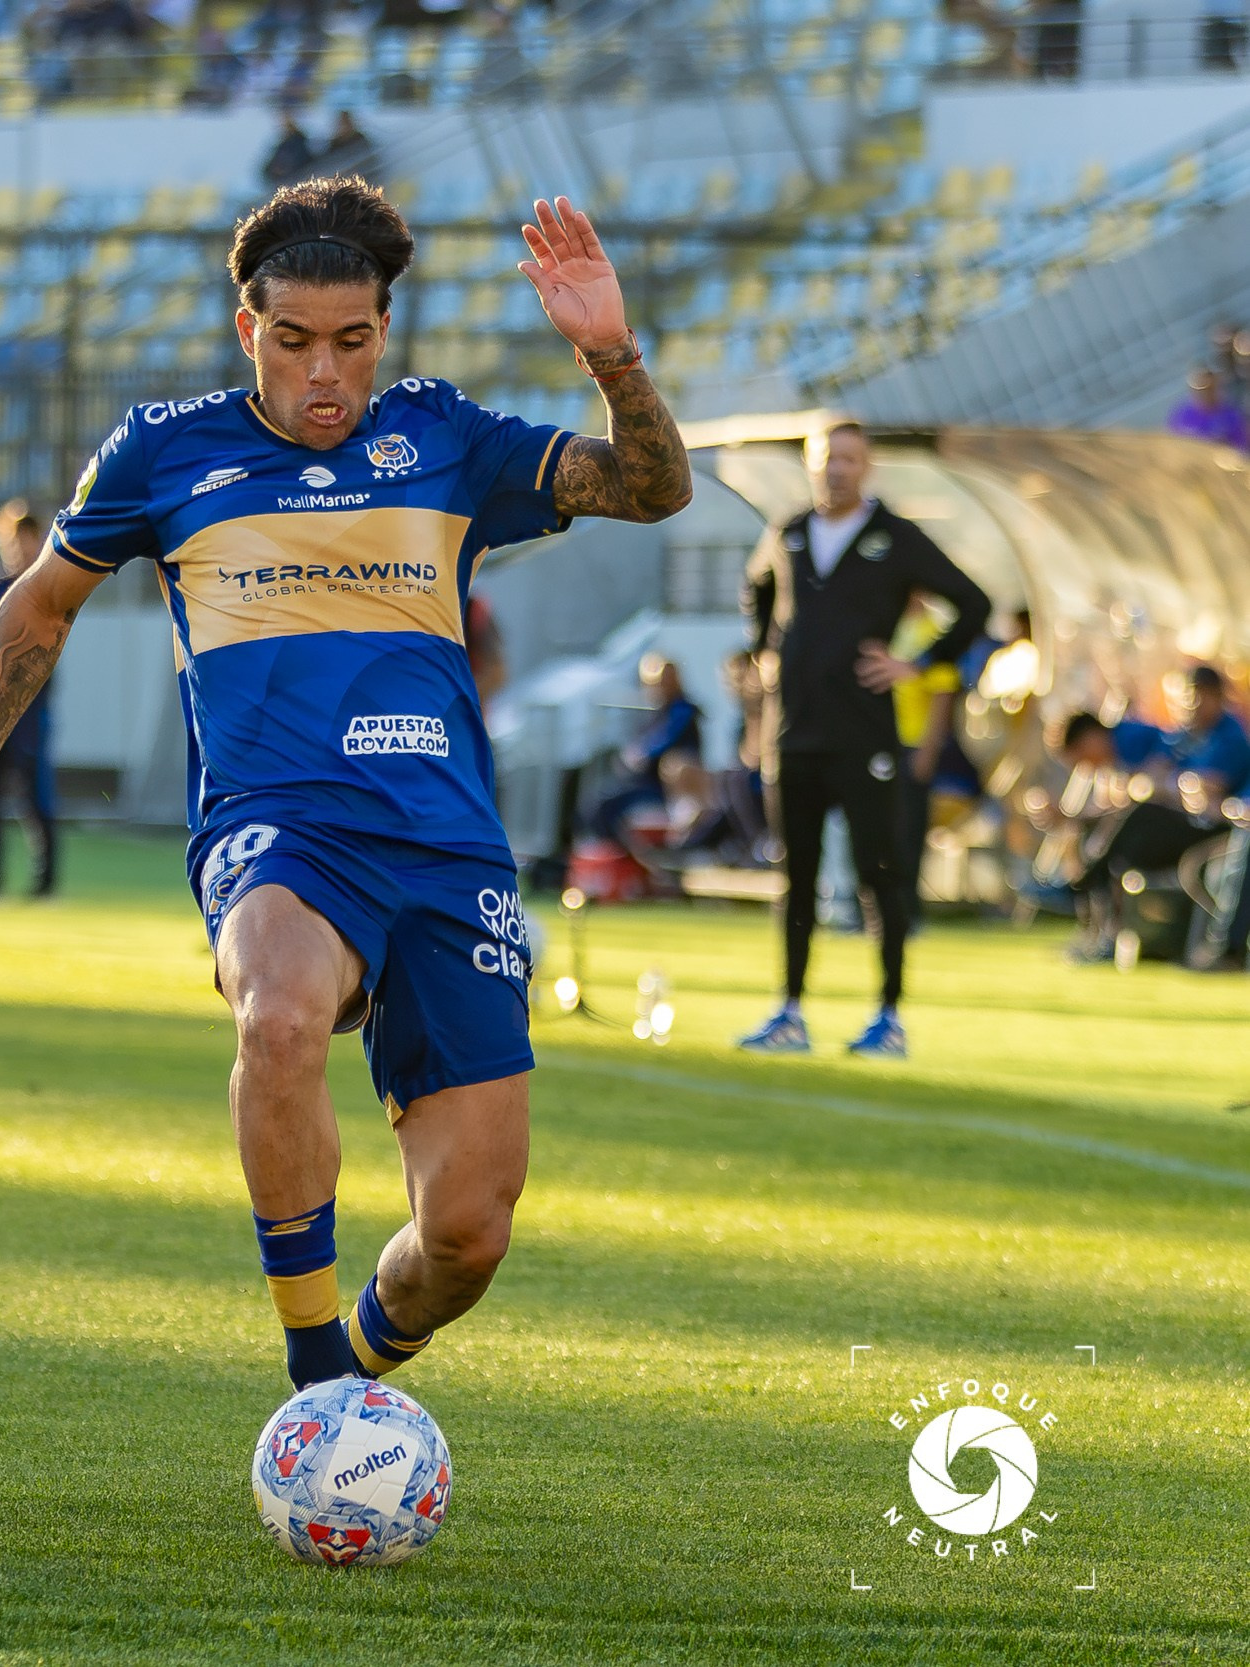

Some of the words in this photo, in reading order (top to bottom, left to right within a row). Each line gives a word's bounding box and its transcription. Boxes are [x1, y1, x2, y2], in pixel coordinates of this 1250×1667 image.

[143, 390, 227, 425] Claro
[191, 472, 249, 497] SKECHERS
[277, 493, 365, 510] MallMarina
[232, 562, 438, 589] TERRAWIND
[242, 584, 317, 603] GLOBAL
[327, 583, 440, 596] PROTECTION
[353, 718, 443, 735] APUESTAS
[347, 736, 447, 754] ROYAL.COM
[200, 825, 280, 890] 10
[333, 1445, 407, 1491] molten
